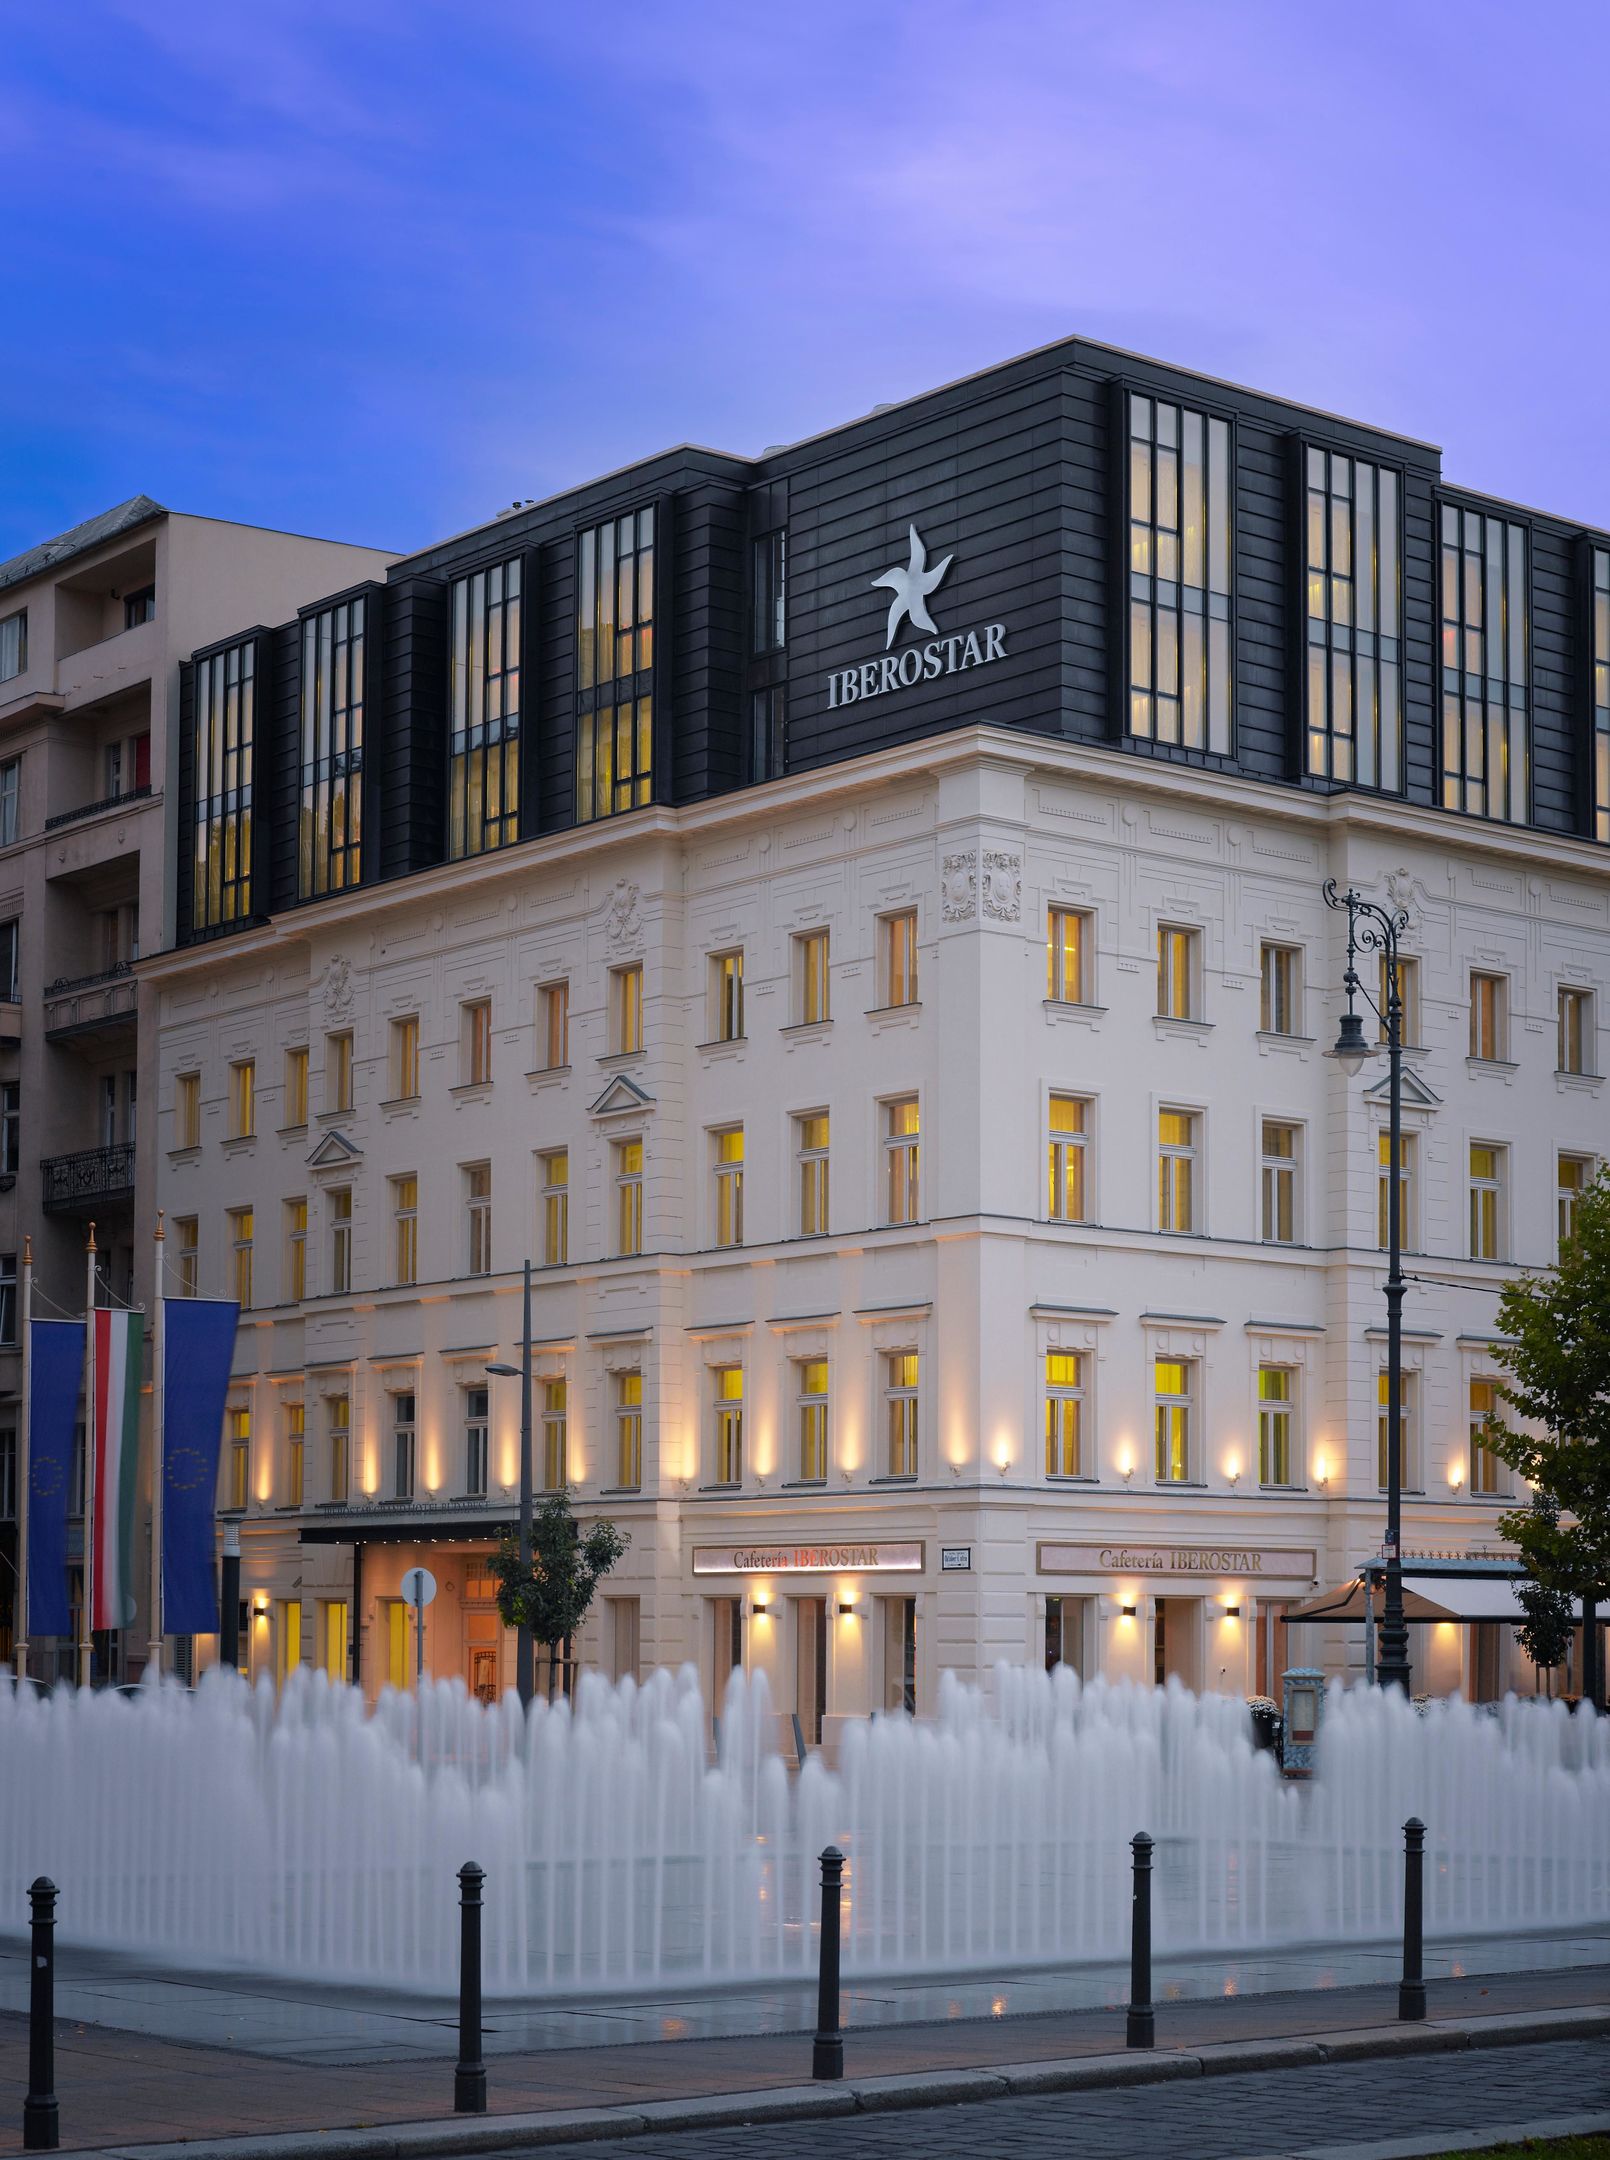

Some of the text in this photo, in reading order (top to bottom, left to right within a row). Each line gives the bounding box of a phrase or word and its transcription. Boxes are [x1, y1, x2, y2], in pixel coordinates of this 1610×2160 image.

[827, 623, 1008, 709] IBEROSTAR
[734, 1548, 878, 1568] Cafetería IBEROSTAR
[1100, 1550, 1262, 1571] Cafetería IBEROSTAR
